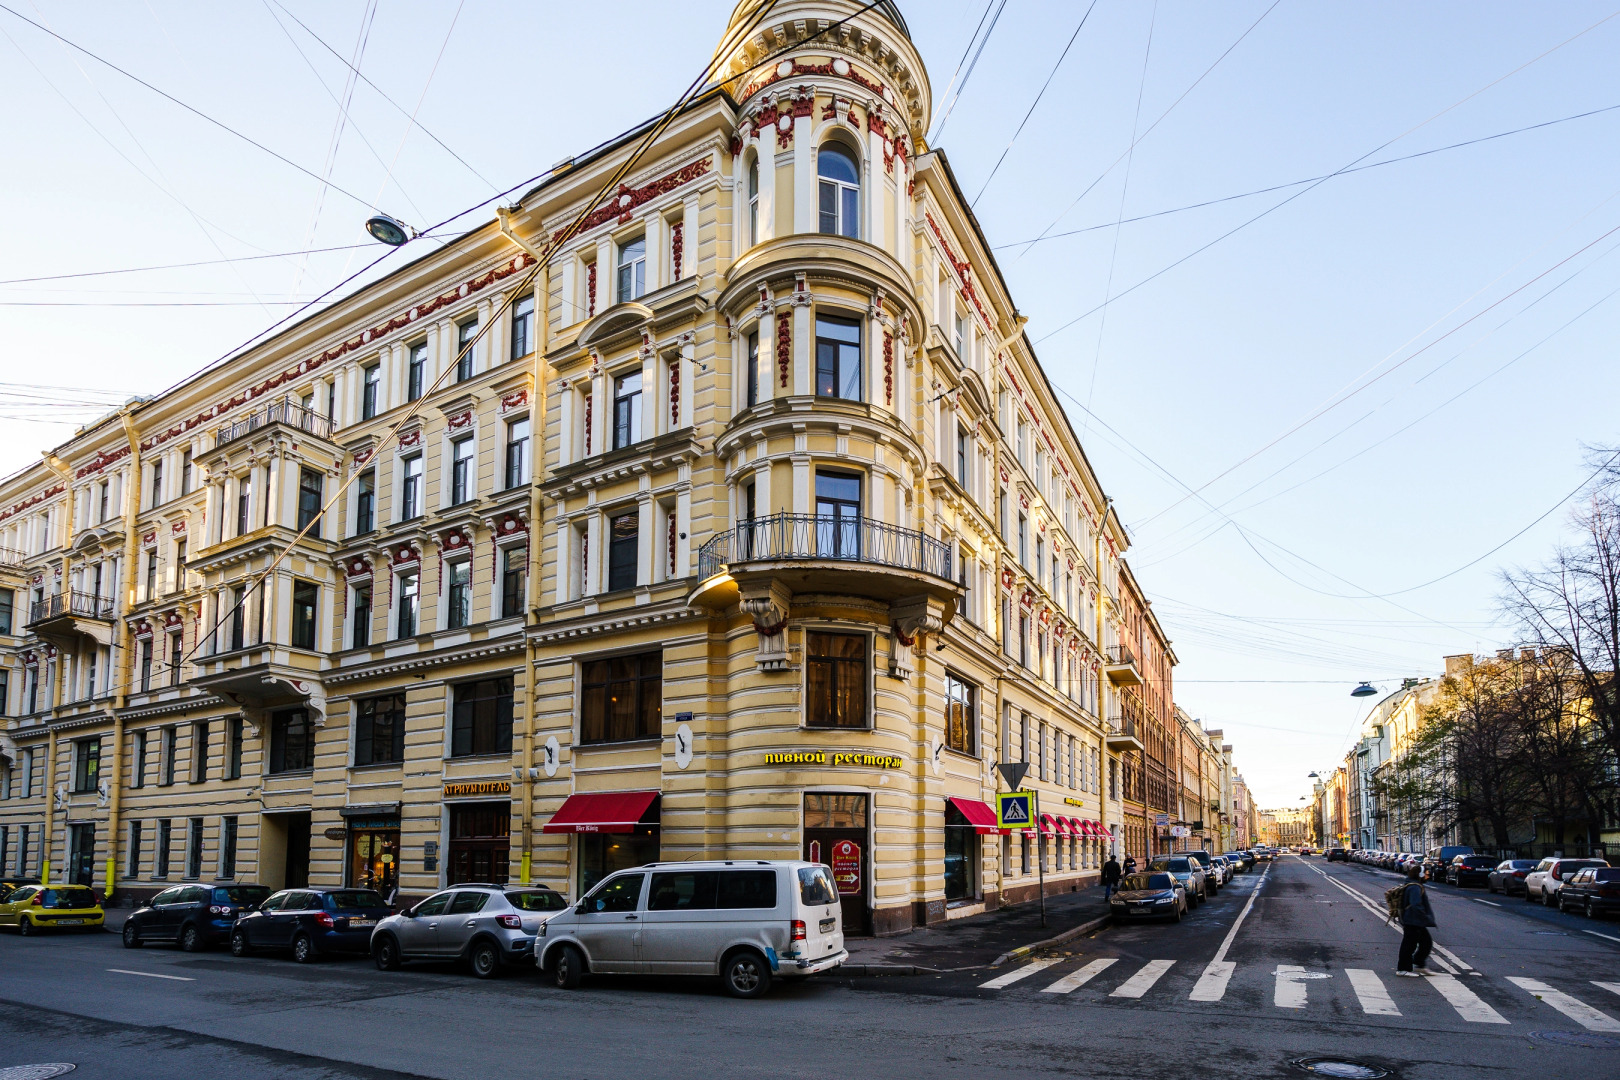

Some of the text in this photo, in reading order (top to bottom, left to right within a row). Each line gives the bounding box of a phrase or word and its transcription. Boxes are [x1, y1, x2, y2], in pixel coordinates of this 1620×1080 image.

[764, 750, 903, 768] пивной ресторан
[443, 782, 510, 795] АТРИУМ ОТЕЛЬ
